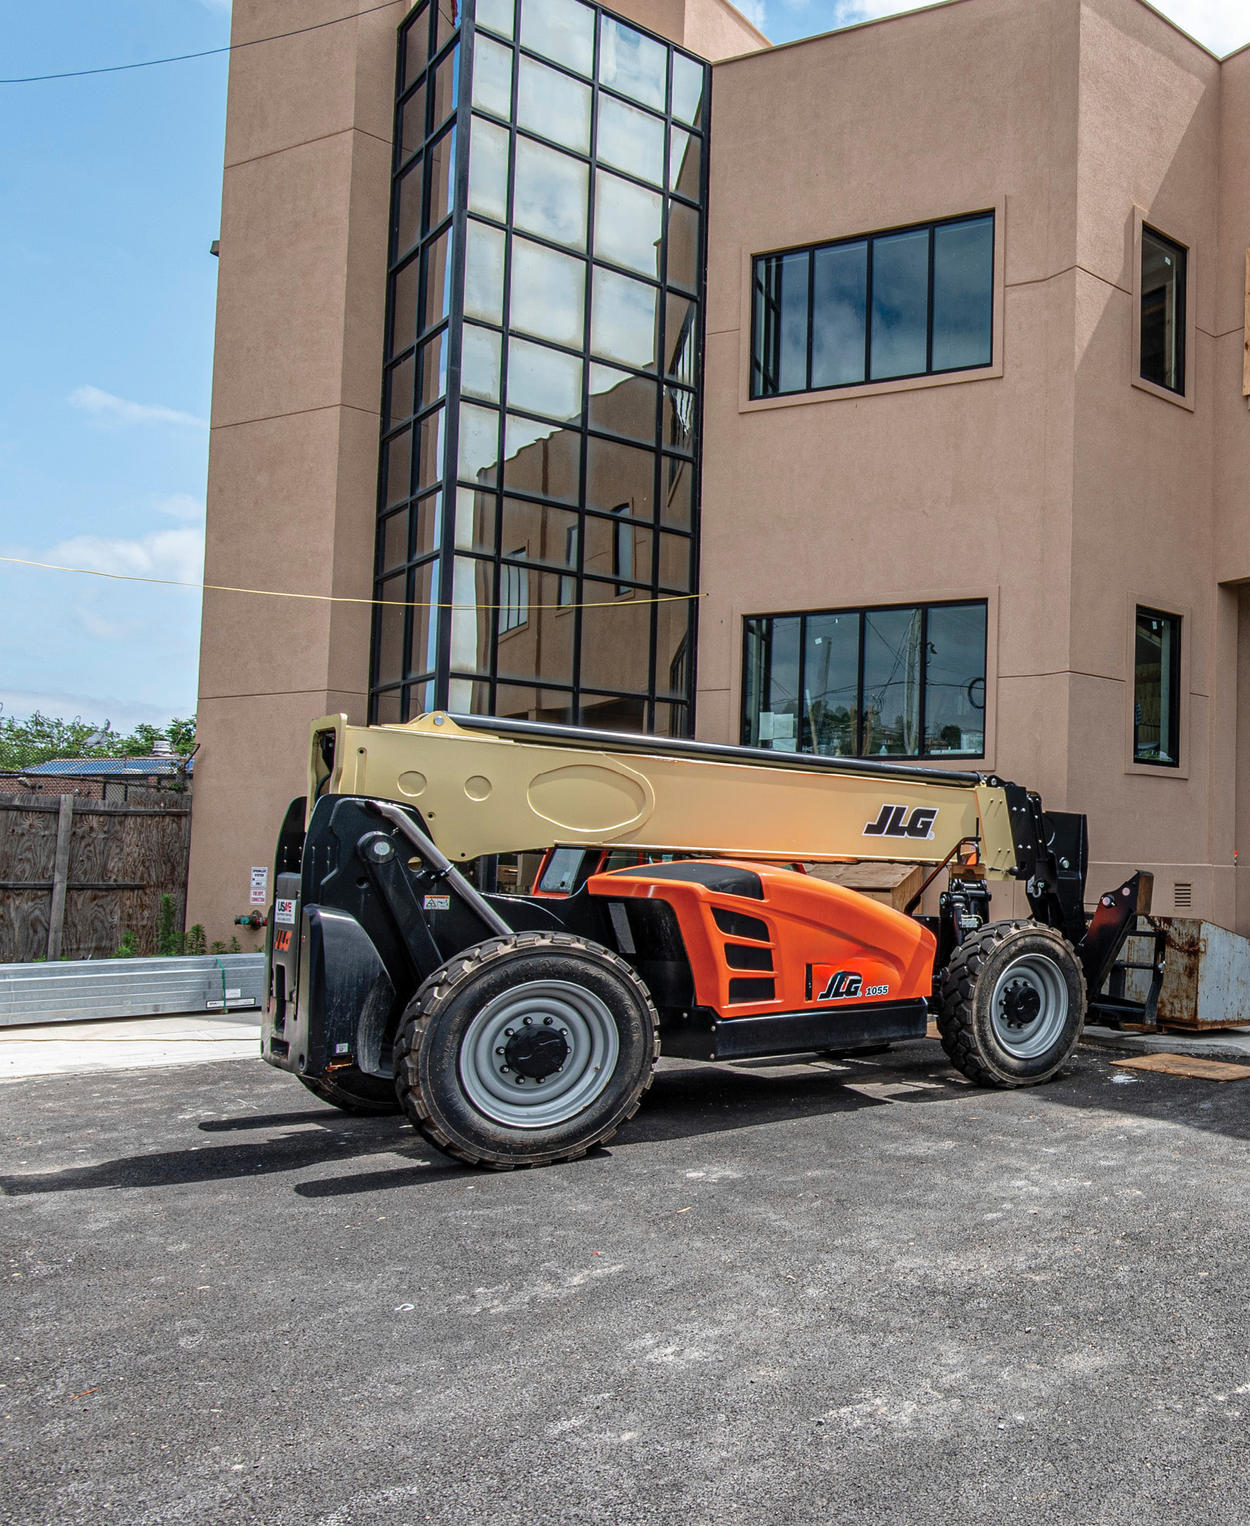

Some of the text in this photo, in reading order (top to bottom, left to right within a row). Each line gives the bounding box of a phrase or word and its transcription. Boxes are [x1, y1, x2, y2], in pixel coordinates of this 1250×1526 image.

[862, 804, 939, 840] JLG
[274, 929, 292, 951] JLG
[817, 970, 889, 1001] JLG 1055
